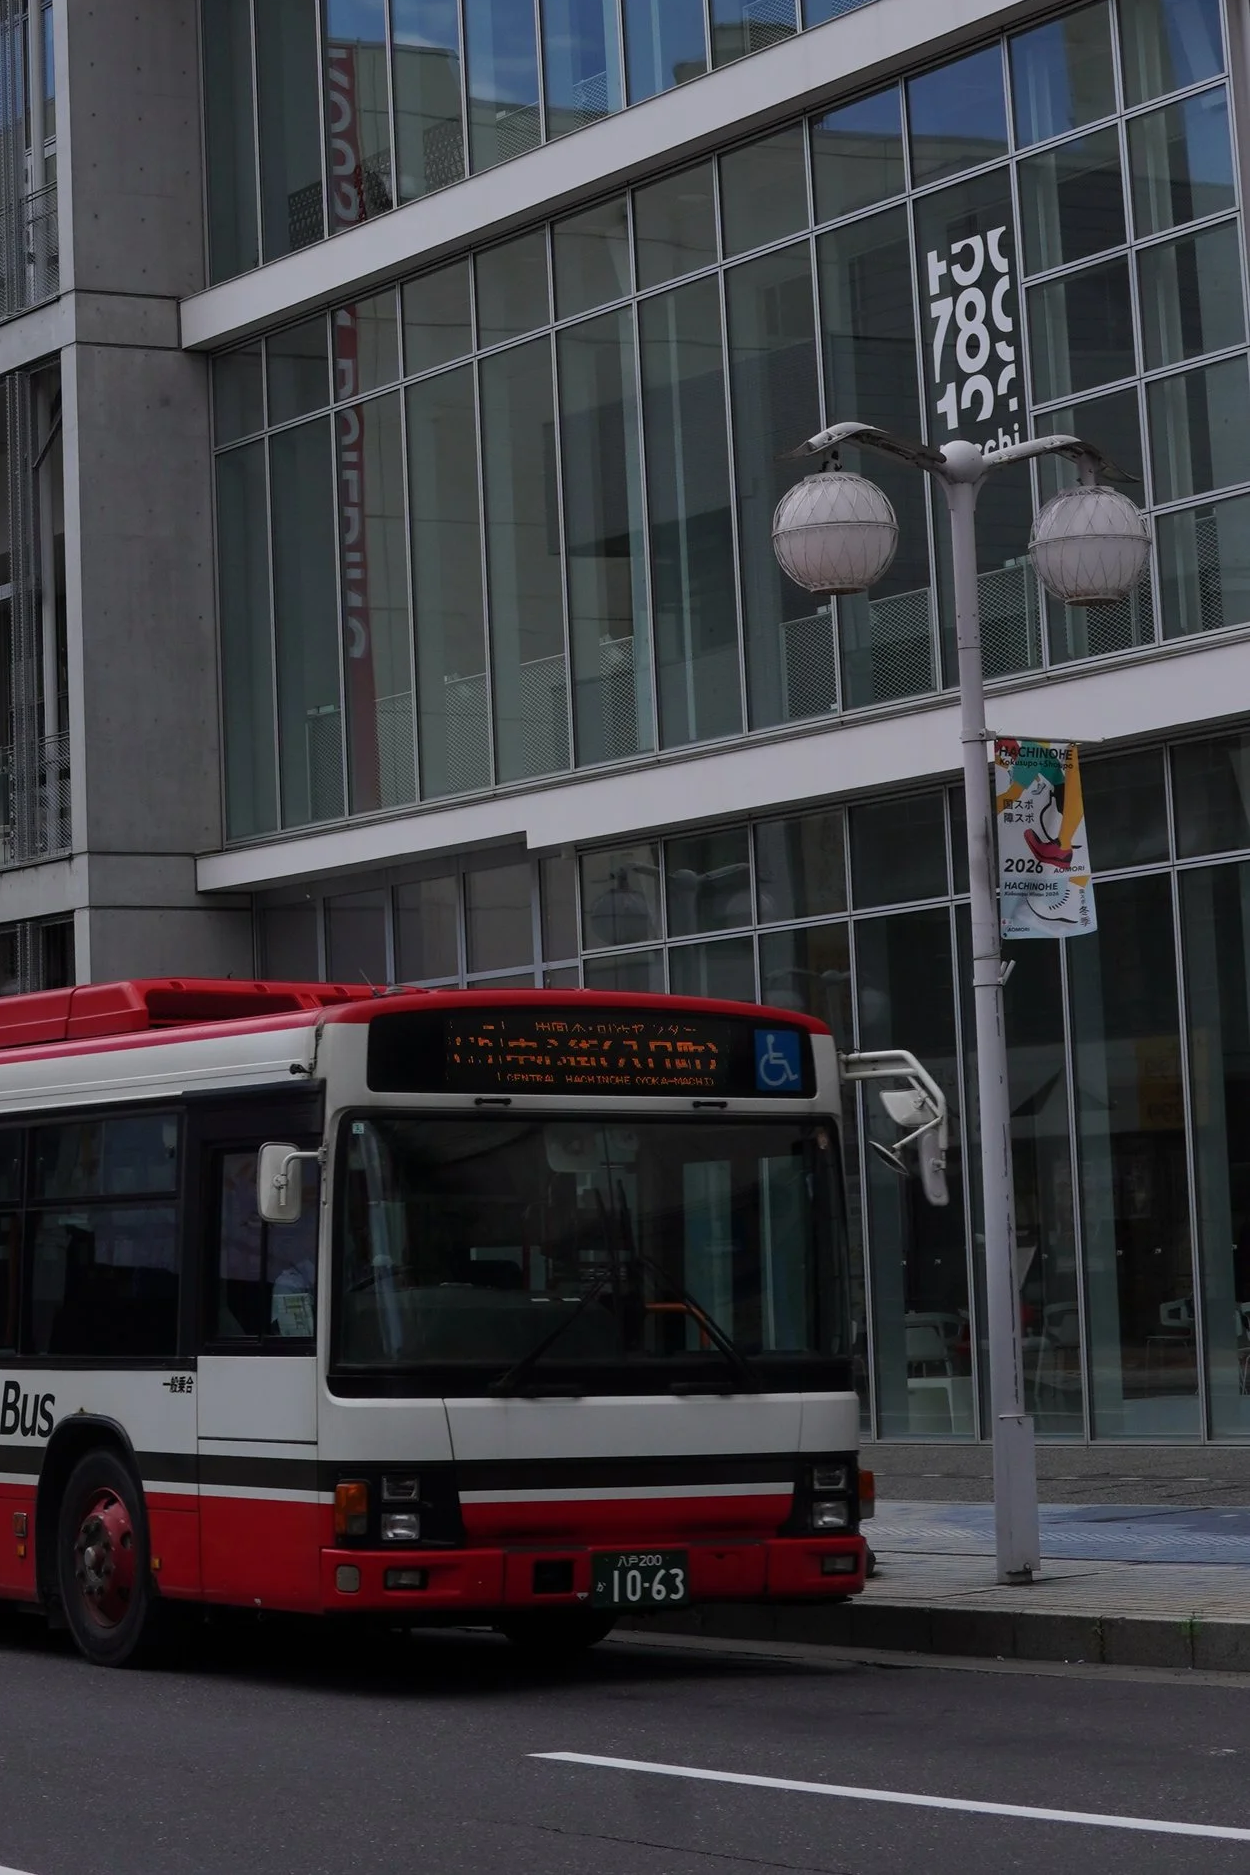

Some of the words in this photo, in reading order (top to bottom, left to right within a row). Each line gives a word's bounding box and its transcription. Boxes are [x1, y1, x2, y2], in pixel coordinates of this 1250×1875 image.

[999, 745, 1073, 761] HACHINOHE
[1003, 799, 1034, 811] 国スポ
[1003, 812, 1035, 824] 障スポ
[1003, 858, 1044, 874] 2026
[1053, 865, 1085, 874] AOMORI
[1004, 881, 1059, 891] HACHINOHE
[0, 1380, 56, 1440] Bus
[613, 1567, 685, 1603] 10-63
